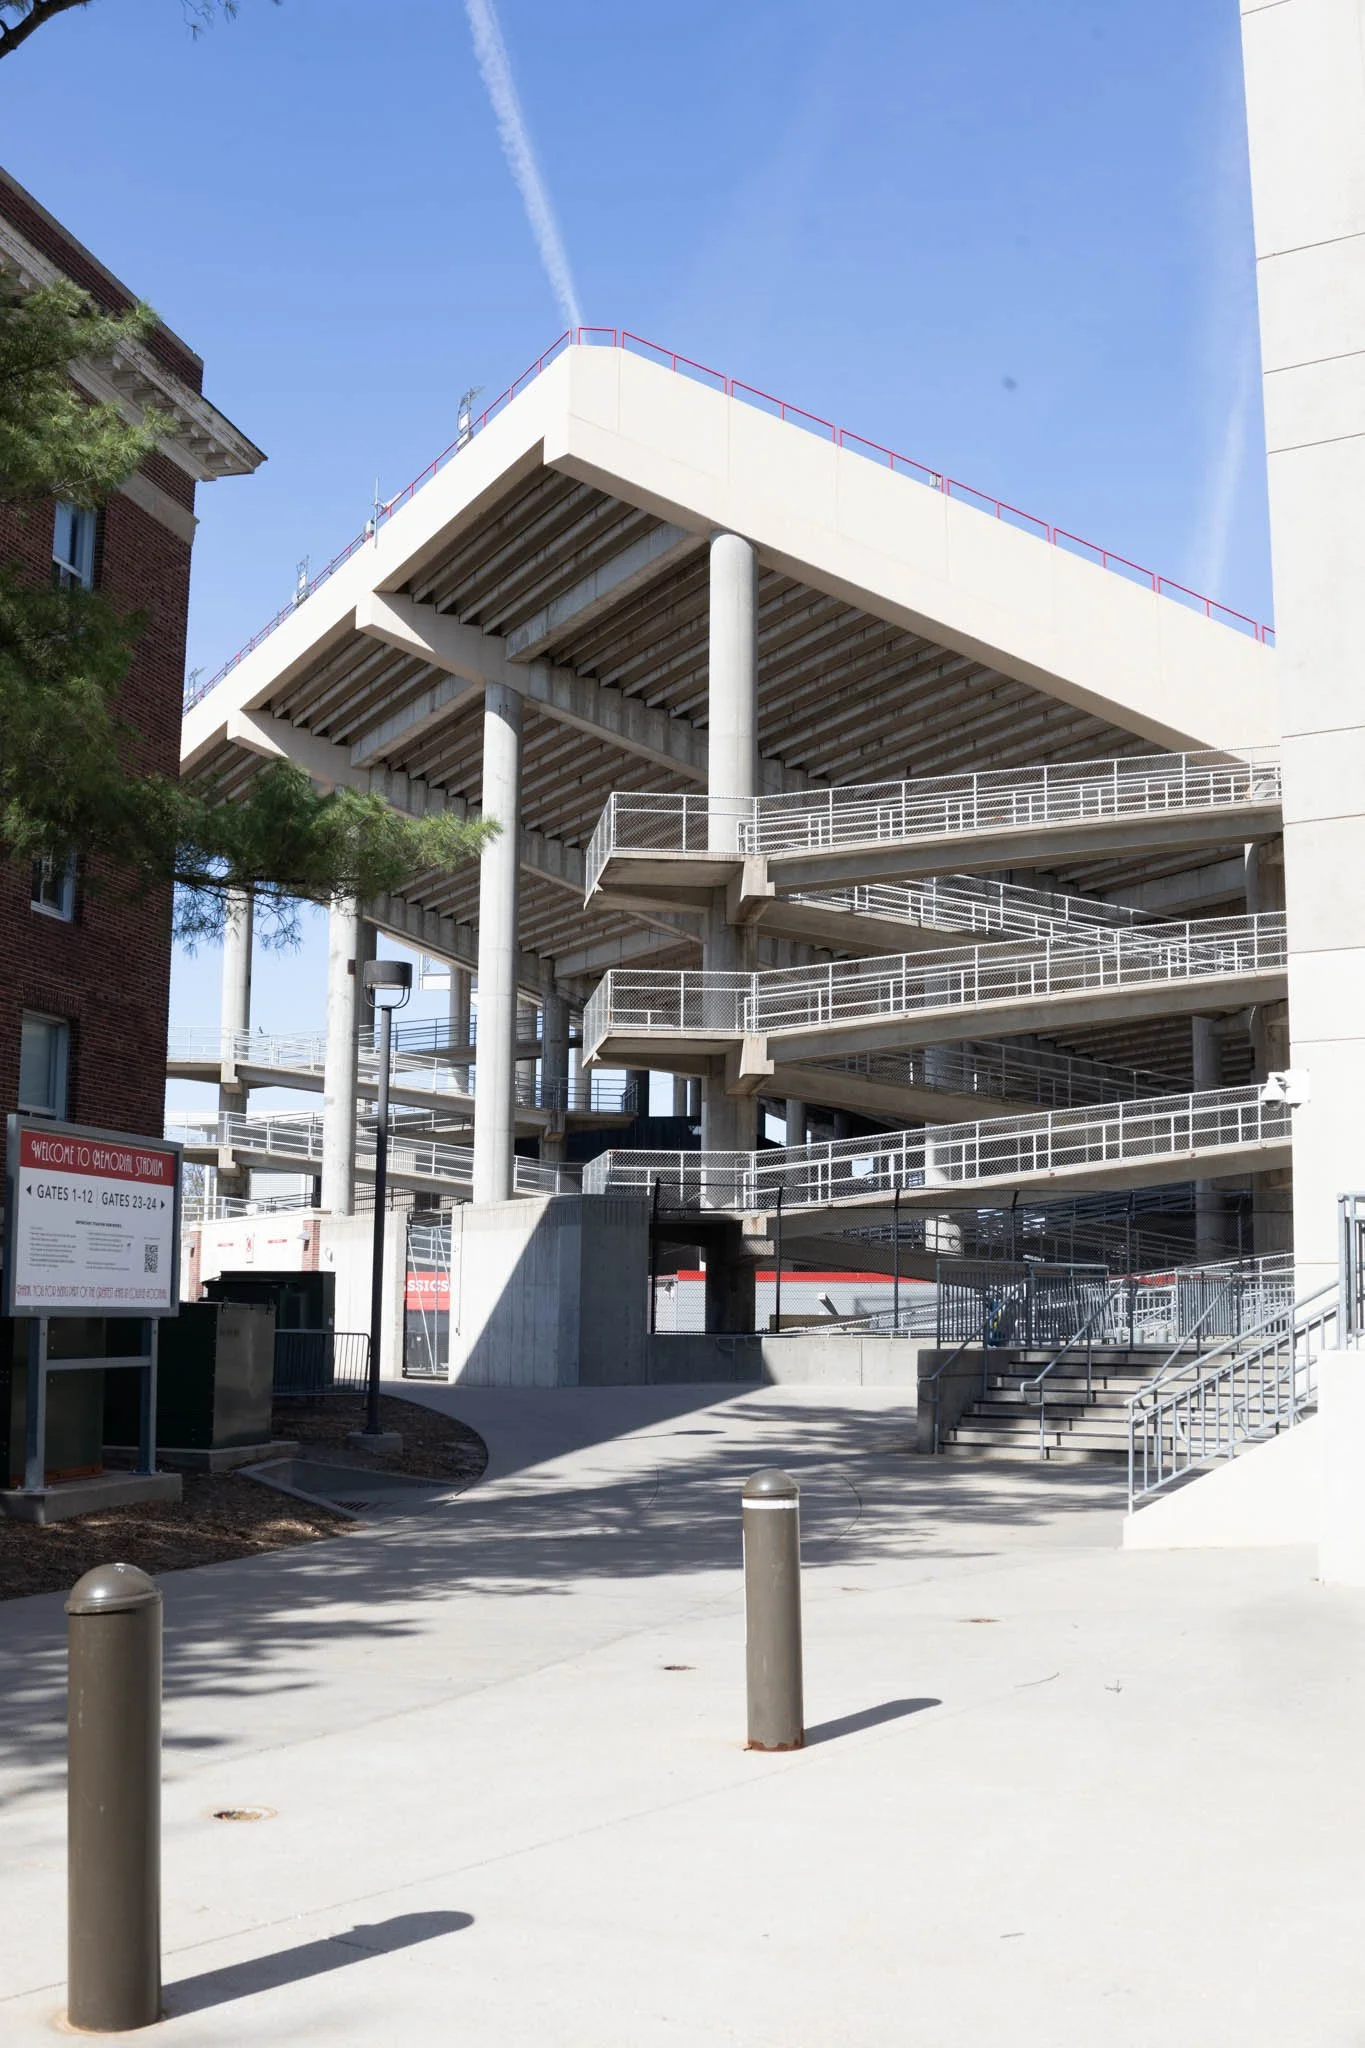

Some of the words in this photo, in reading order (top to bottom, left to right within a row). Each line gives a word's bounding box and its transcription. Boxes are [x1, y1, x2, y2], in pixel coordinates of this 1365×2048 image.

[31, 1140, 75, 1165] WELCOME
[76, 1147, 90, 1167] TO
[92, 1149, 133, 1174] MEMORIAL
[134, 1156, 164, 1177] STADIUM
[37, 1184, 69, 1201] GATES
[72, 1188, 93, 1204] 1-12
[102, 1191, 130, 1208] GATES
[132, 1195, 157, 1210] 23-24
[405, 1279, 449, 1292] SSICS
